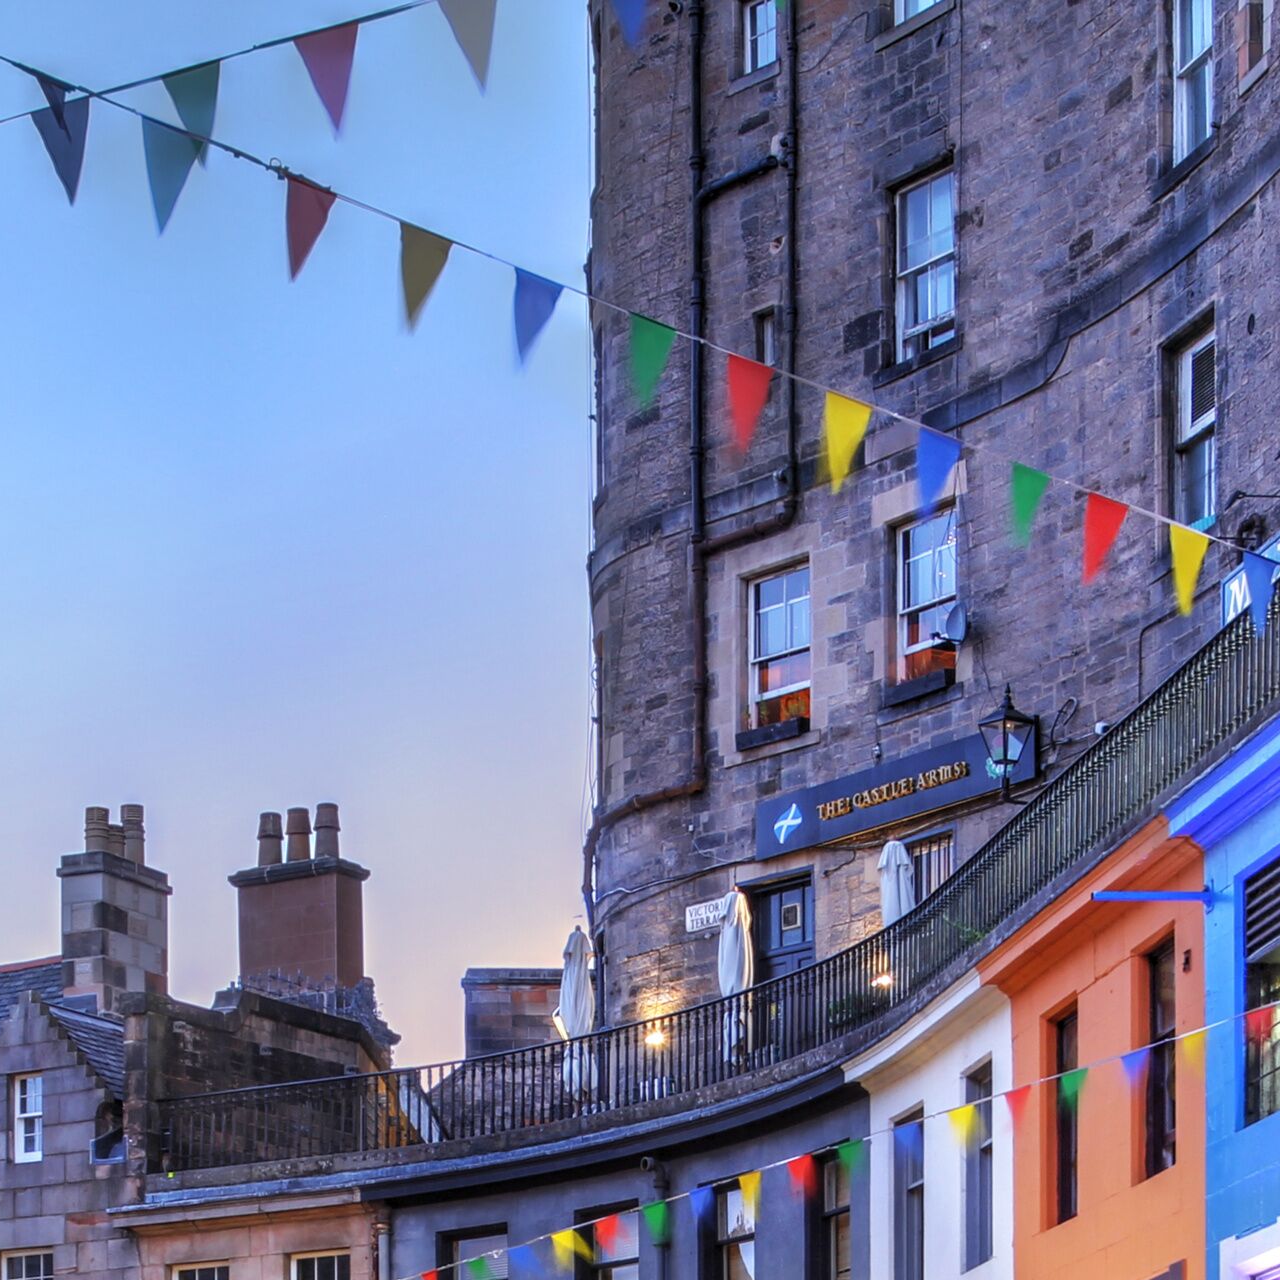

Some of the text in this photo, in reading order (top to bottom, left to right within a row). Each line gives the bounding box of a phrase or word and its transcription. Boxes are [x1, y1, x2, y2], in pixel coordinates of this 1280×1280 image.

[816, 761, 969, 820] THE CASTLE ARMS
